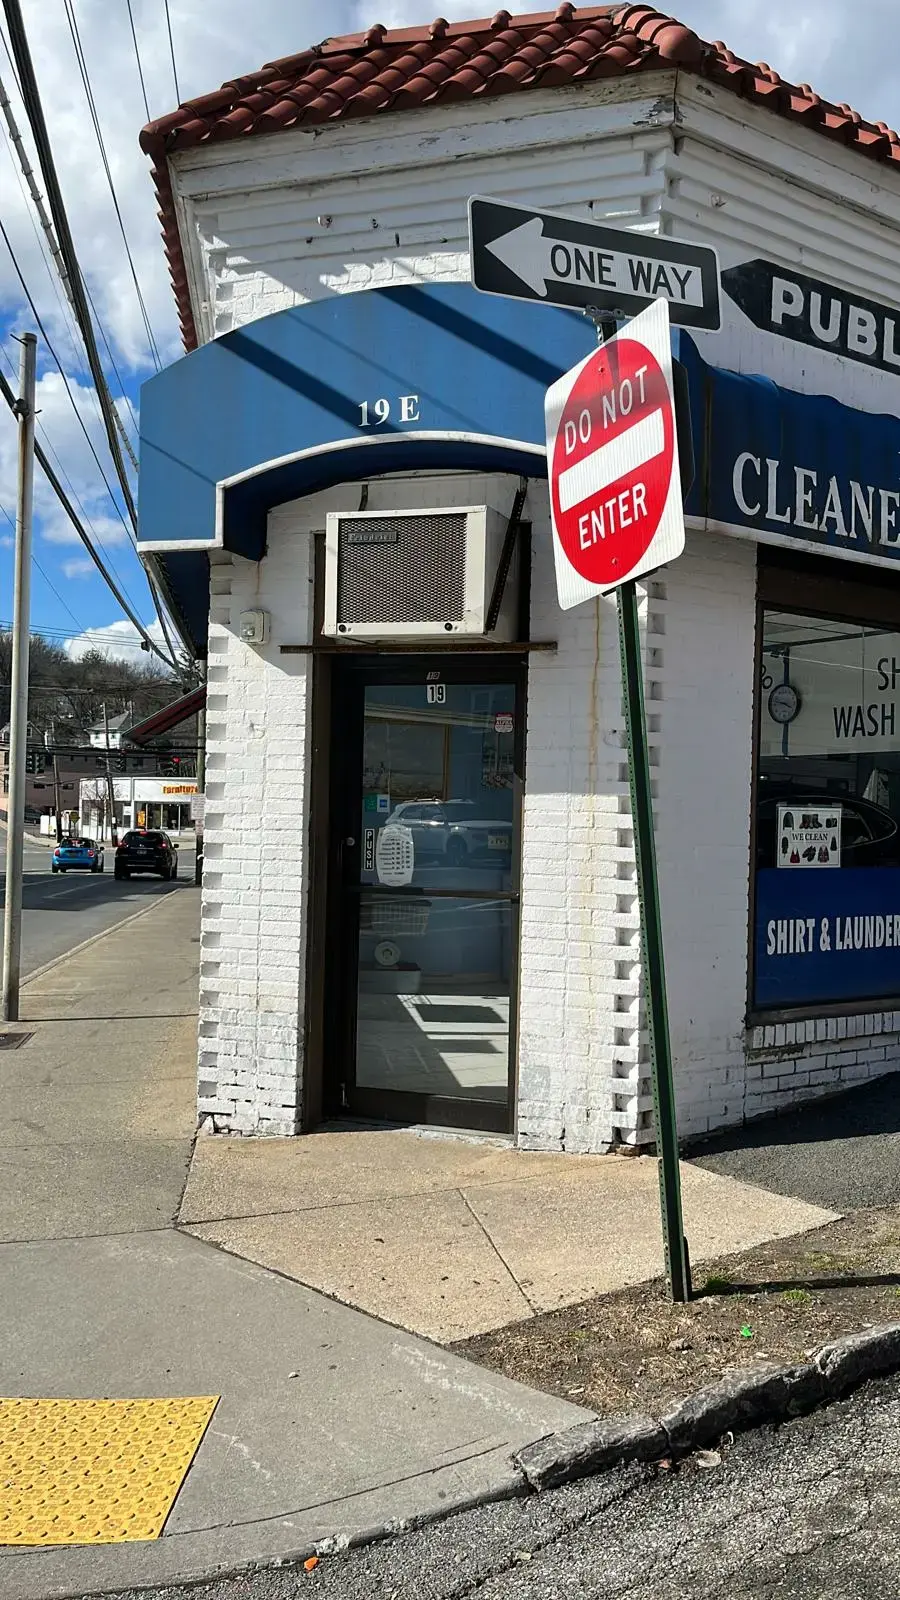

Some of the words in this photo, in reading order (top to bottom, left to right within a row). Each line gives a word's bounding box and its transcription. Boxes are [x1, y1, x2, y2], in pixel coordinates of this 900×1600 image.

[550, 244, 617, 287] ONE
[628, 258, 693, 300] WAY
[772, 278, 900, 365] PUBL
[358, 398, 390, 427] 19
[399, 395, 420, 422] E
[565, 409, 592, 456] DO
[602, 365, 649, 430] NOT
[579, 483, 648, 550] ENTER
[733, 452, 900, 548] CLEANE
[429, 685, 444, 702] 19
[833, 703, 895, 738] WASH
[792, 833, 803, 841] WE
[805, 833, 828, 841] CLEAN
[767, 918, 816, 955] SHIRT
[819, 917, 831, 951] &
